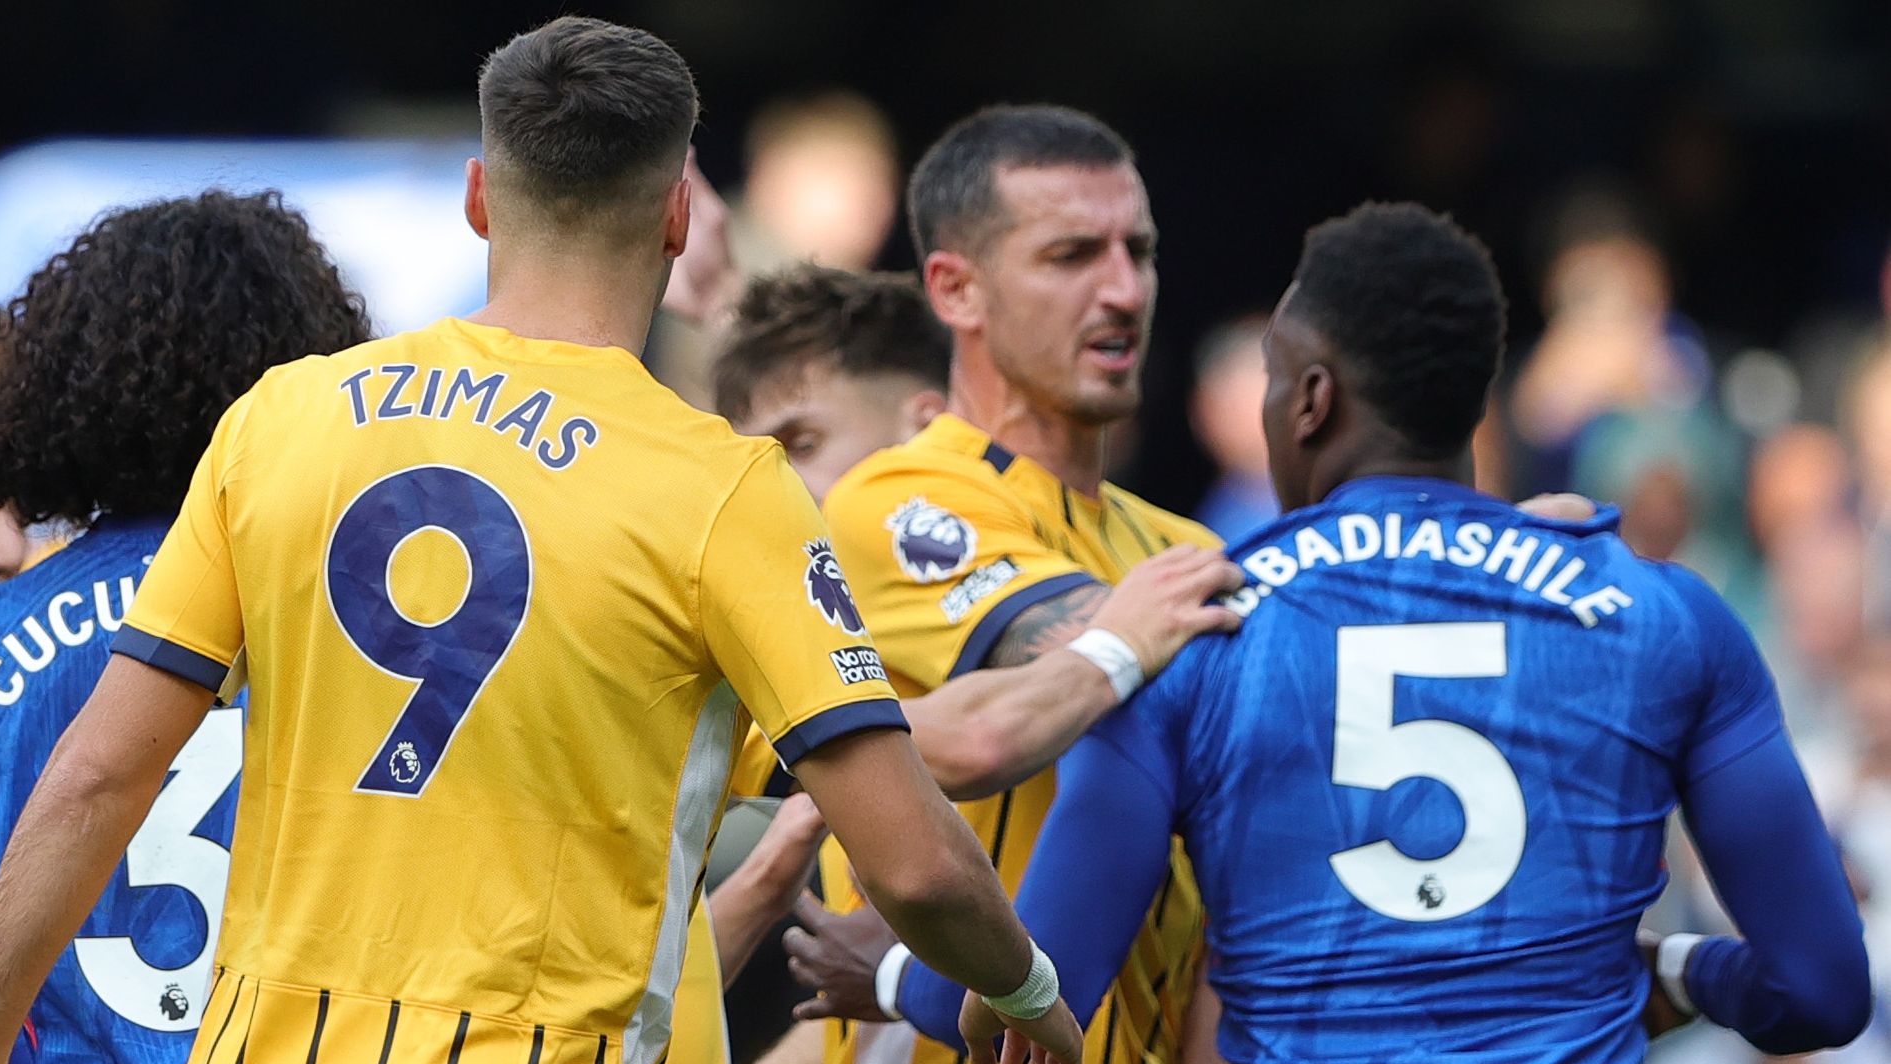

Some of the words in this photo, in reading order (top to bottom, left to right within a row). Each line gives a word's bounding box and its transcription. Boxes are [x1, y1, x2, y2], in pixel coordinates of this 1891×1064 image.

[339, 364, 599, 472] TZIMAS
[323, 463, 534, 799] 9
[829, 648, 860, 671] No
[1329, 621, 1527, 921] 5
[73, 707, 243, 1033] 3
